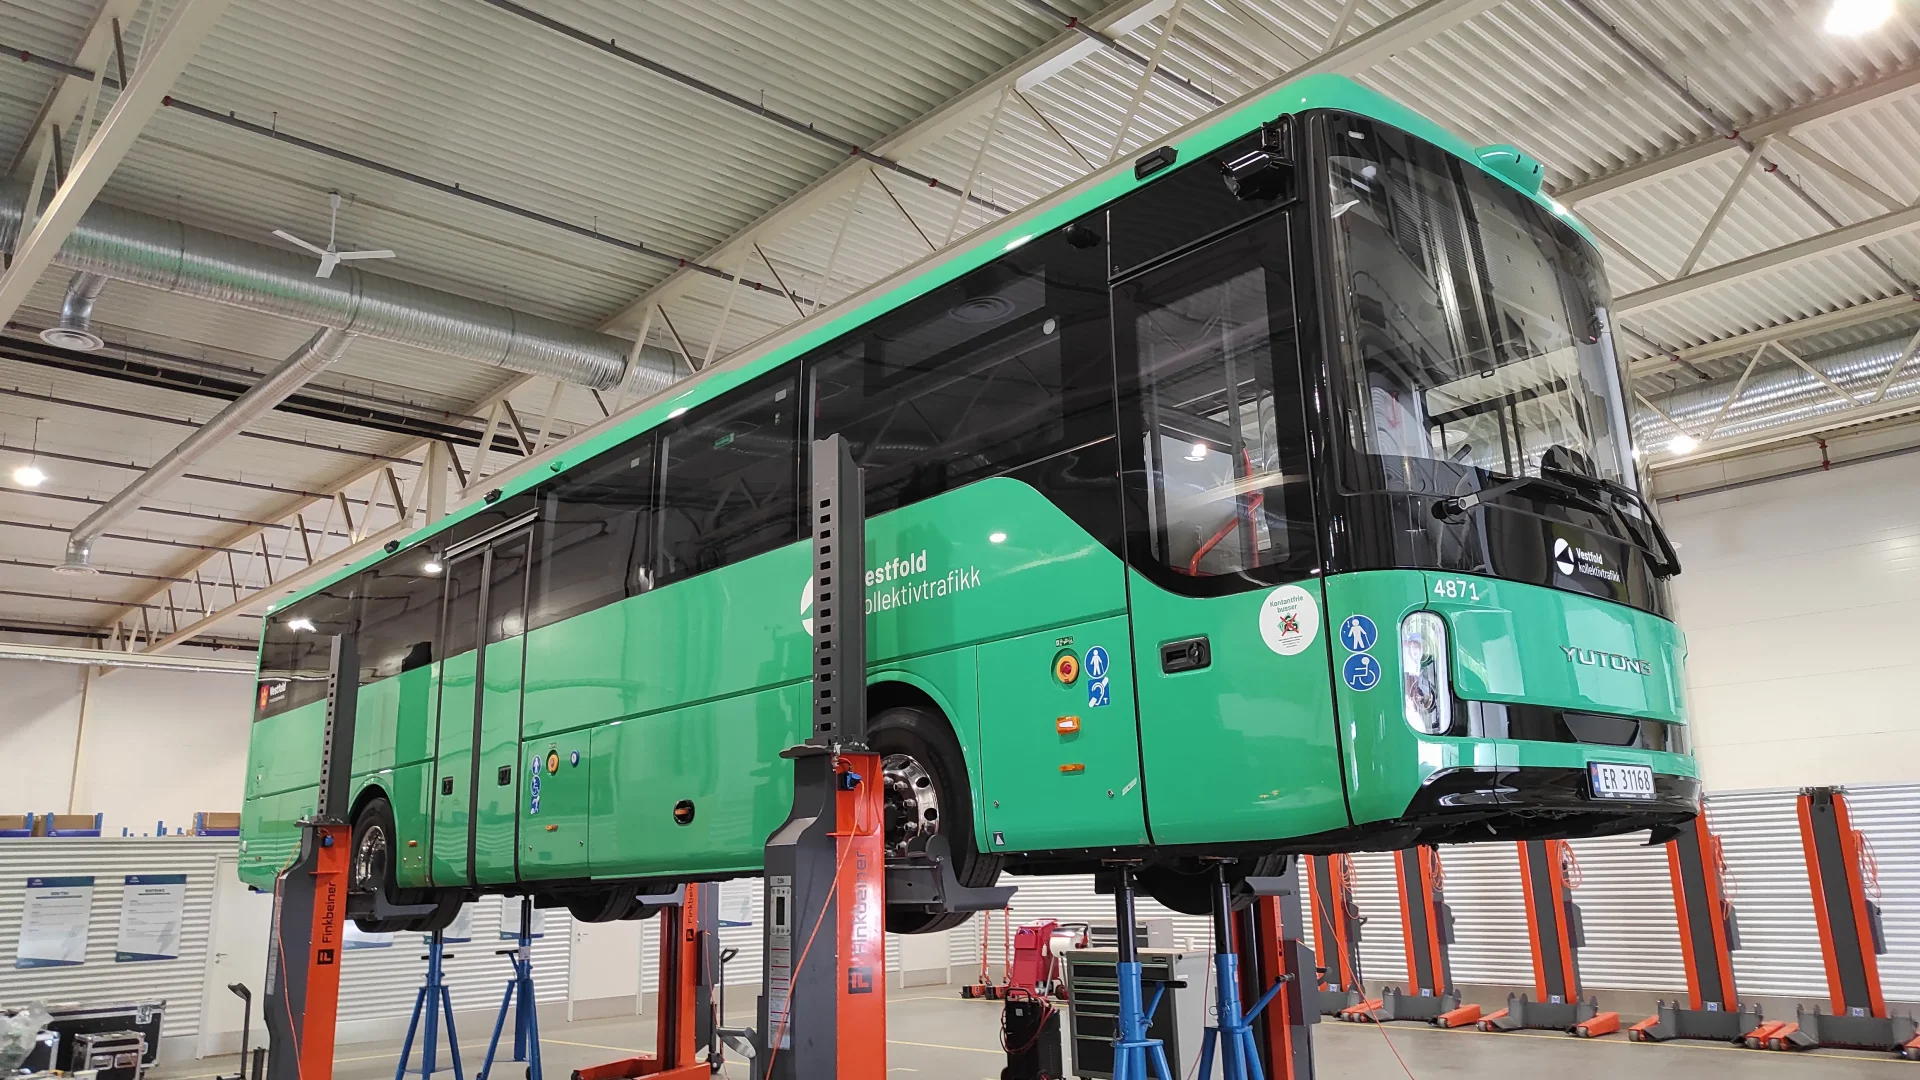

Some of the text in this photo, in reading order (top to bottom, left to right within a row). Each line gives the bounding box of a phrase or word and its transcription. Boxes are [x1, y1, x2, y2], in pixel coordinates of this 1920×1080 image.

[1575, 547, 1603, 565] Vestfold
[865, 549, 927, 587] estfold
[1577, 561, 1621, 583] kollektivtrafikk
[865, 565, 981, 615] ollektivtrafikk
[1270, 594, 1304, 608] Kontantfrie
[1434, 579, 1480, 601] 4871
[1277, 604, 1298, 613] busser
[1559, 645, 1652, 676] YUTONG
[1603, 768, 1651, 791] ER 31168
[322, 881, 336, 943] Finkbeiner
[851, 851, 867, 956] Finkbeiner
